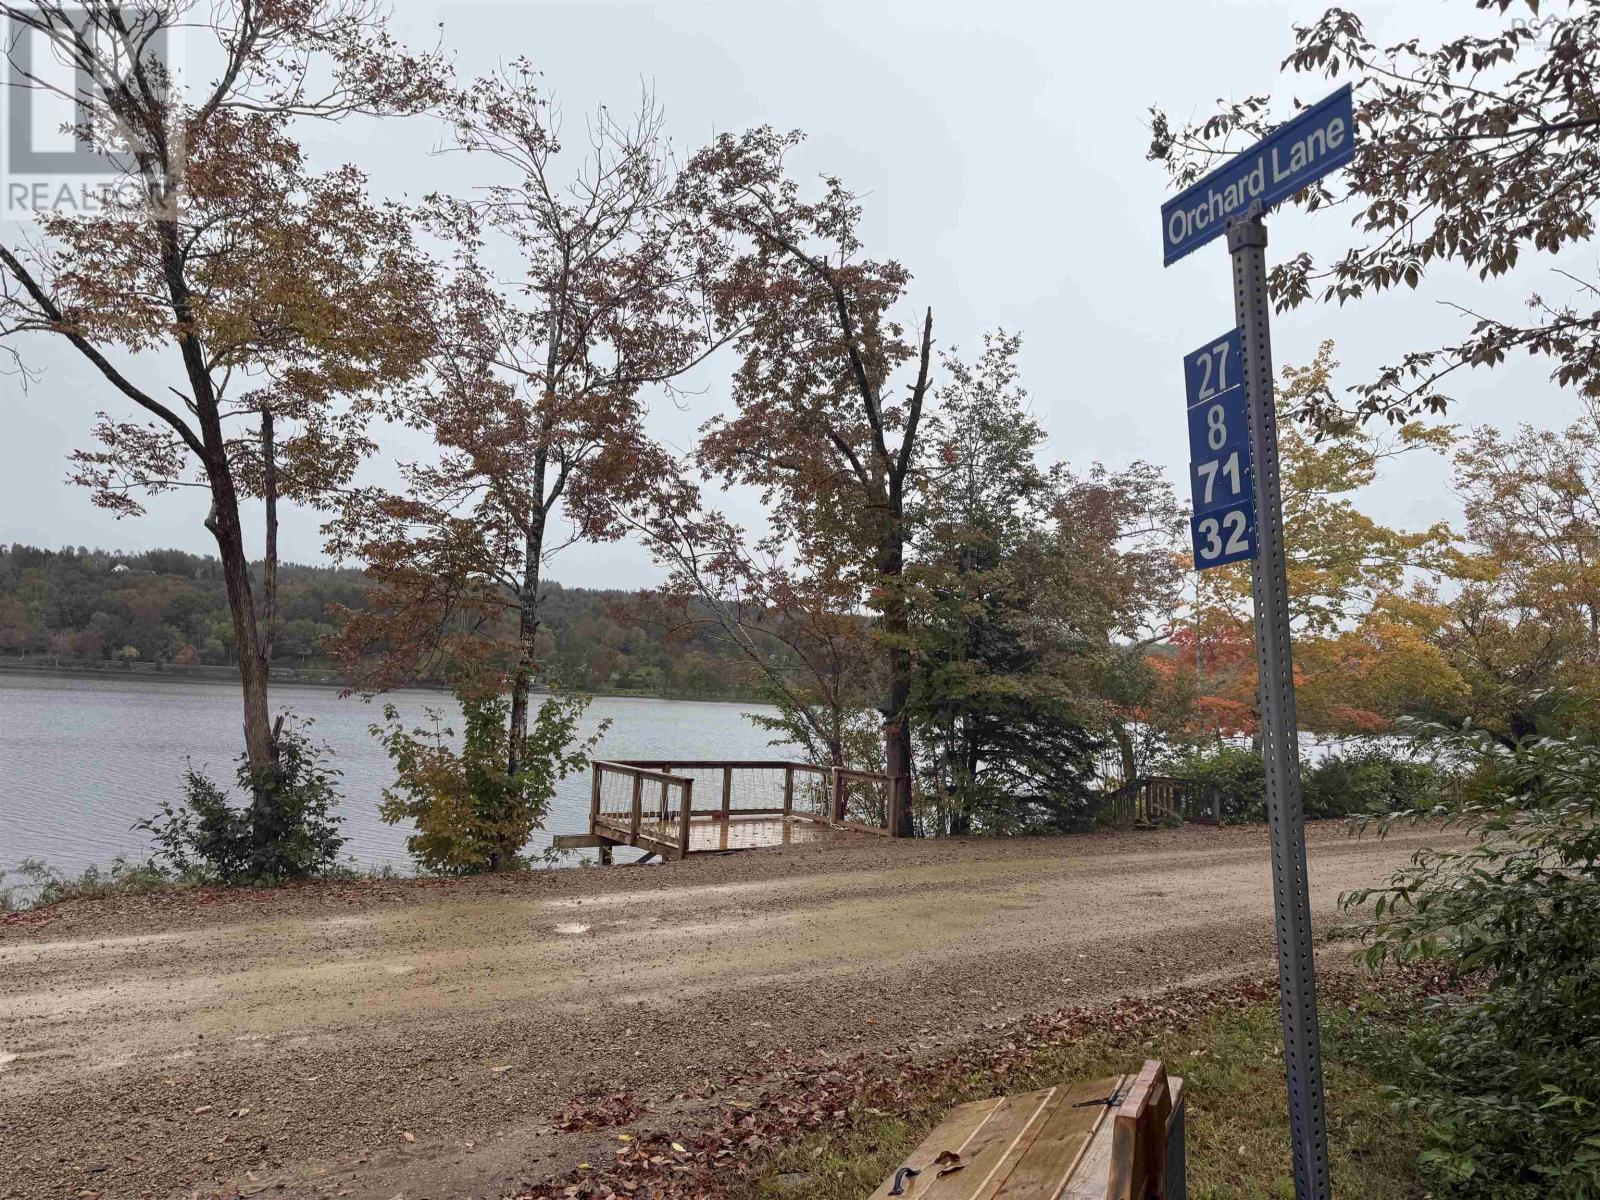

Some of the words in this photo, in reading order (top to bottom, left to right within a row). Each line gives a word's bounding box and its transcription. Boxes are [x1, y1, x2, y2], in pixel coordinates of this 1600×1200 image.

[1168, 157, 1264, 244] Orchard
[1271, 118, 1345, 184] Lane
[1196, 341, 1230, 400] 27
[1207, 404, 1227, 450] 8
[1197, 451, 1241, 504] 71
[1198, 510, 1249, 560] 32
